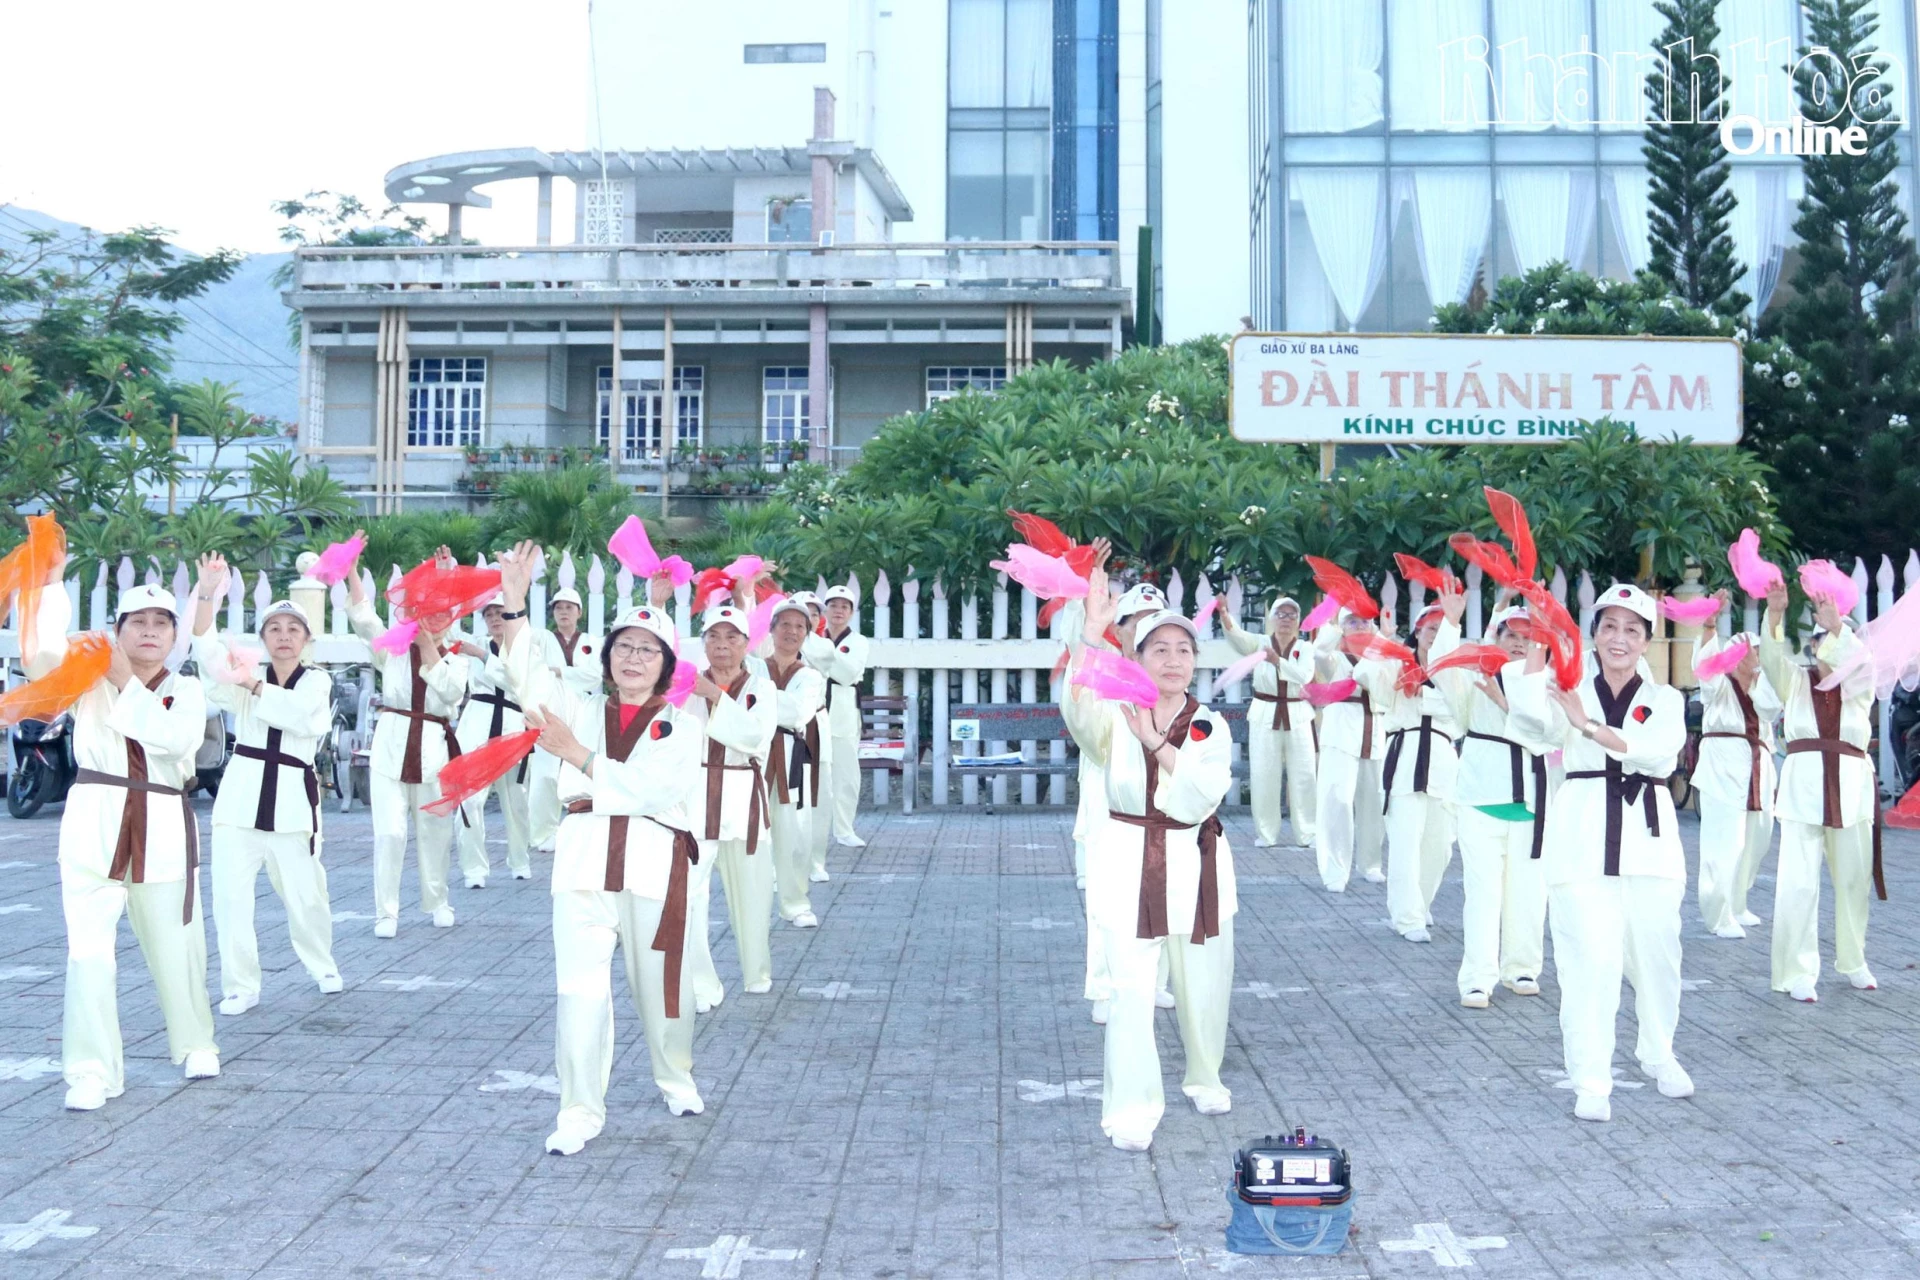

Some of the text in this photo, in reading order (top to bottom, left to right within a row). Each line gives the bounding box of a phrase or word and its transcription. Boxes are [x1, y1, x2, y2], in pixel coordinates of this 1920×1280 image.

[1310, 344, 1325, 354] BA
[1256, 358, 1713, 412] ĐÀI THÁNH TÂM
[1343, 413, 1414, 435] KÍNH
[1425, 414, 1506, 436] CHÚC
